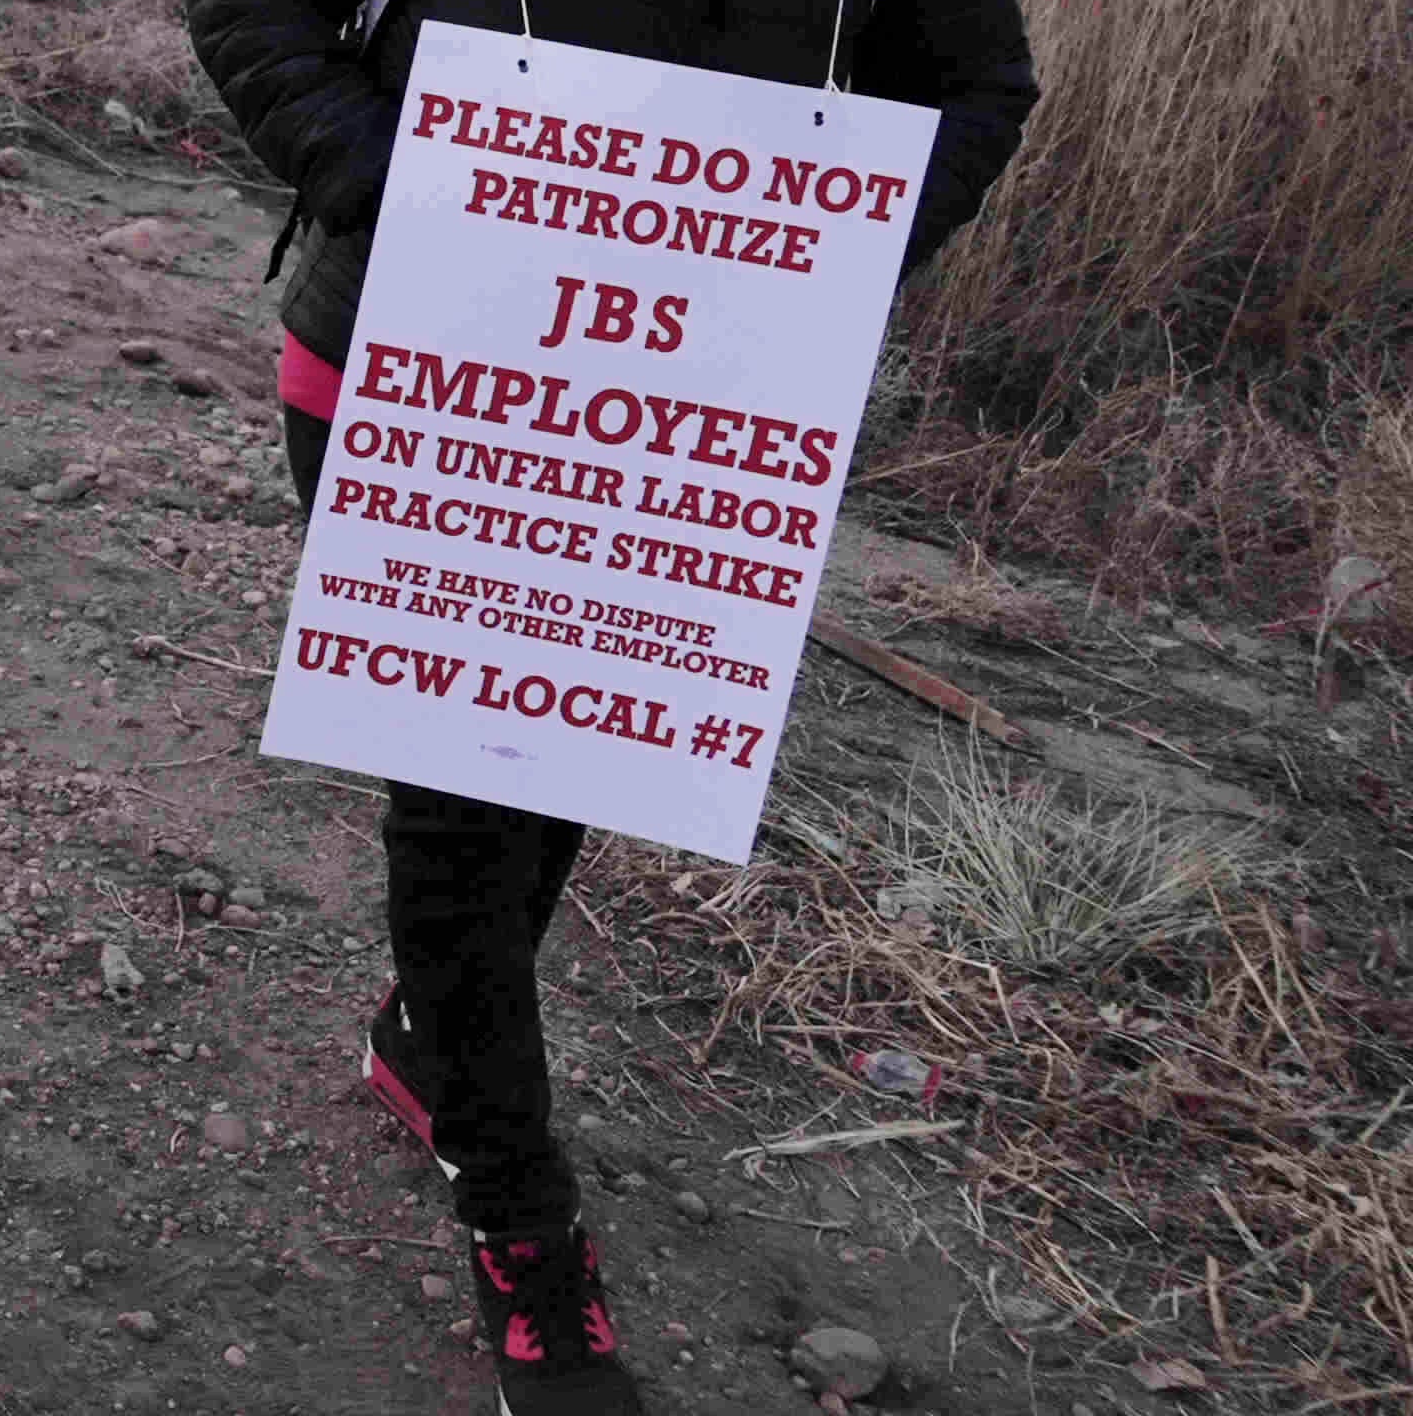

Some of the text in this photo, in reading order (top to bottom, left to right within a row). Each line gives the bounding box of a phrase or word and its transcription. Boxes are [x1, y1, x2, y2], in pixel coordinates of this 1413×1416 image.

[412, 93, 907, 222] PLEASE DO NOT
[464, 168, 821, 274] PATRONIZE
[540, 275, 689, 353] JBS
[356, 342, 838, 487] EMPLOYEES
[330, 477, 804, 609] PRACTICE STRIKE
[343, 421, 818, 550] ON UNFAIR LABOR
[320, 574, 770, 690] WITH ANY OTHER EMPLOYER
[384, 558, 715, 648] WE HAVE NO DISPUTE
[298, 627, 765, 769] UFCW LOCAL #7
